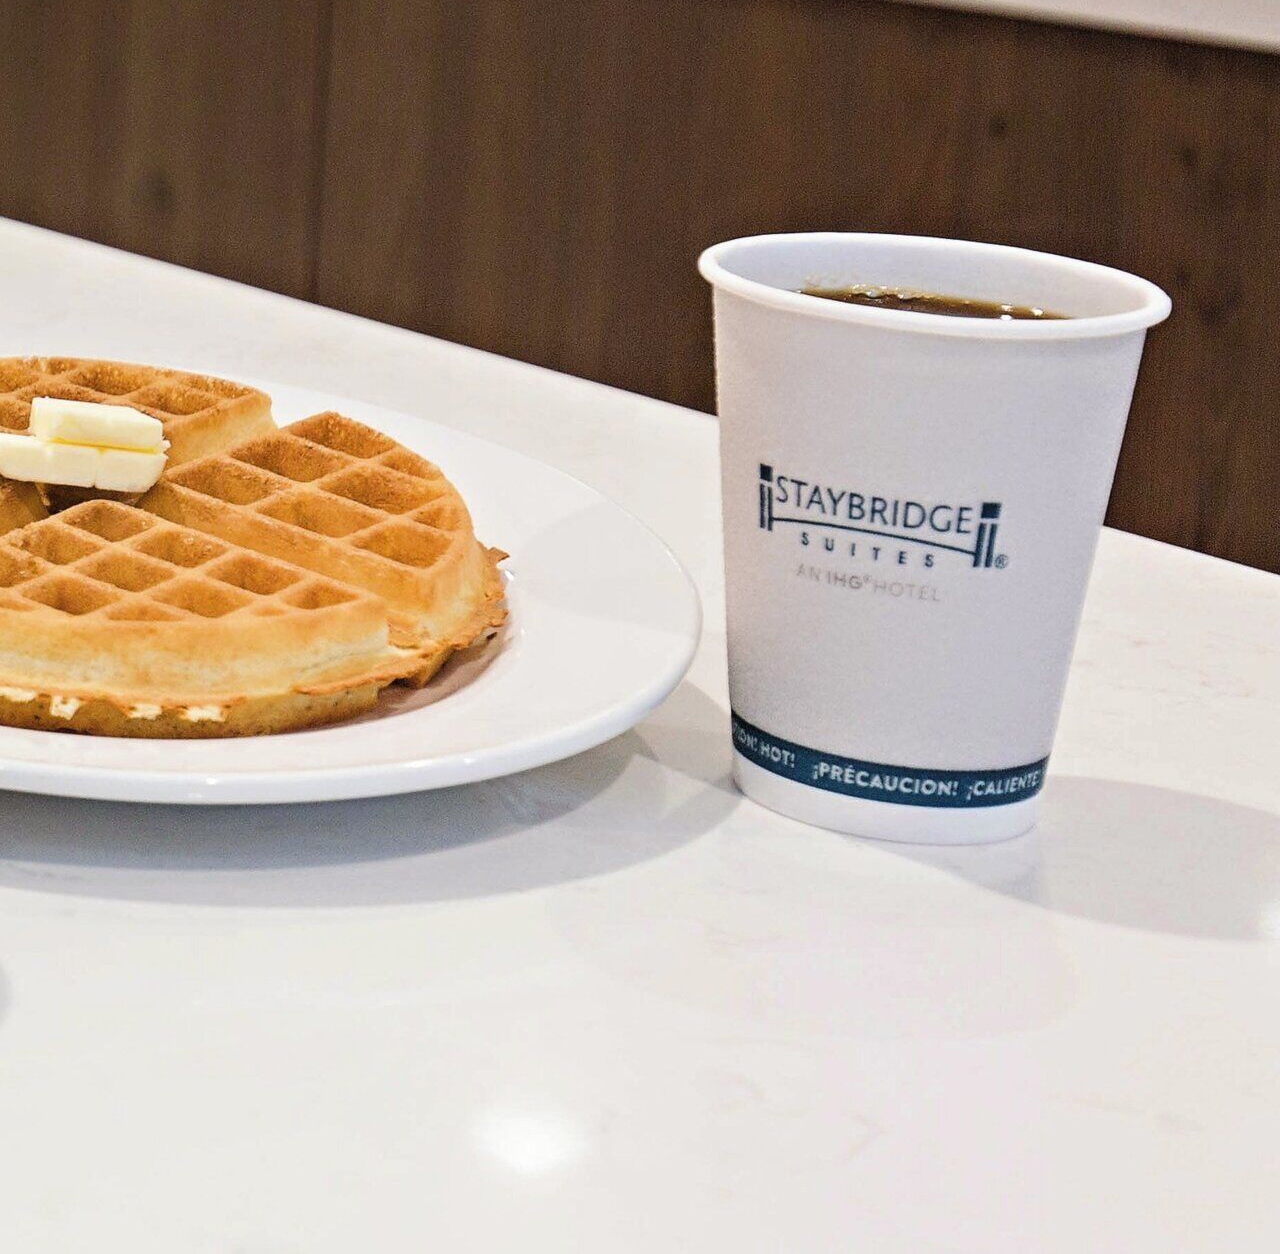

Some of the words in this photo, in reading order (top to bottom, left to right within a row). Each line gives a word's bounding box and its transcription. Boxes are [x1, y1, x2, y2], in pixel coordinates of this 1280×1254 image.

[776, 475, 974, 534] STAYBRIDGE
[801, 532, 936, 568] SUITES
[795, 563, 820, 581] AN
[873, 578, 940, 602] HOTEL
[760, 741, 795, 769] HOT!
